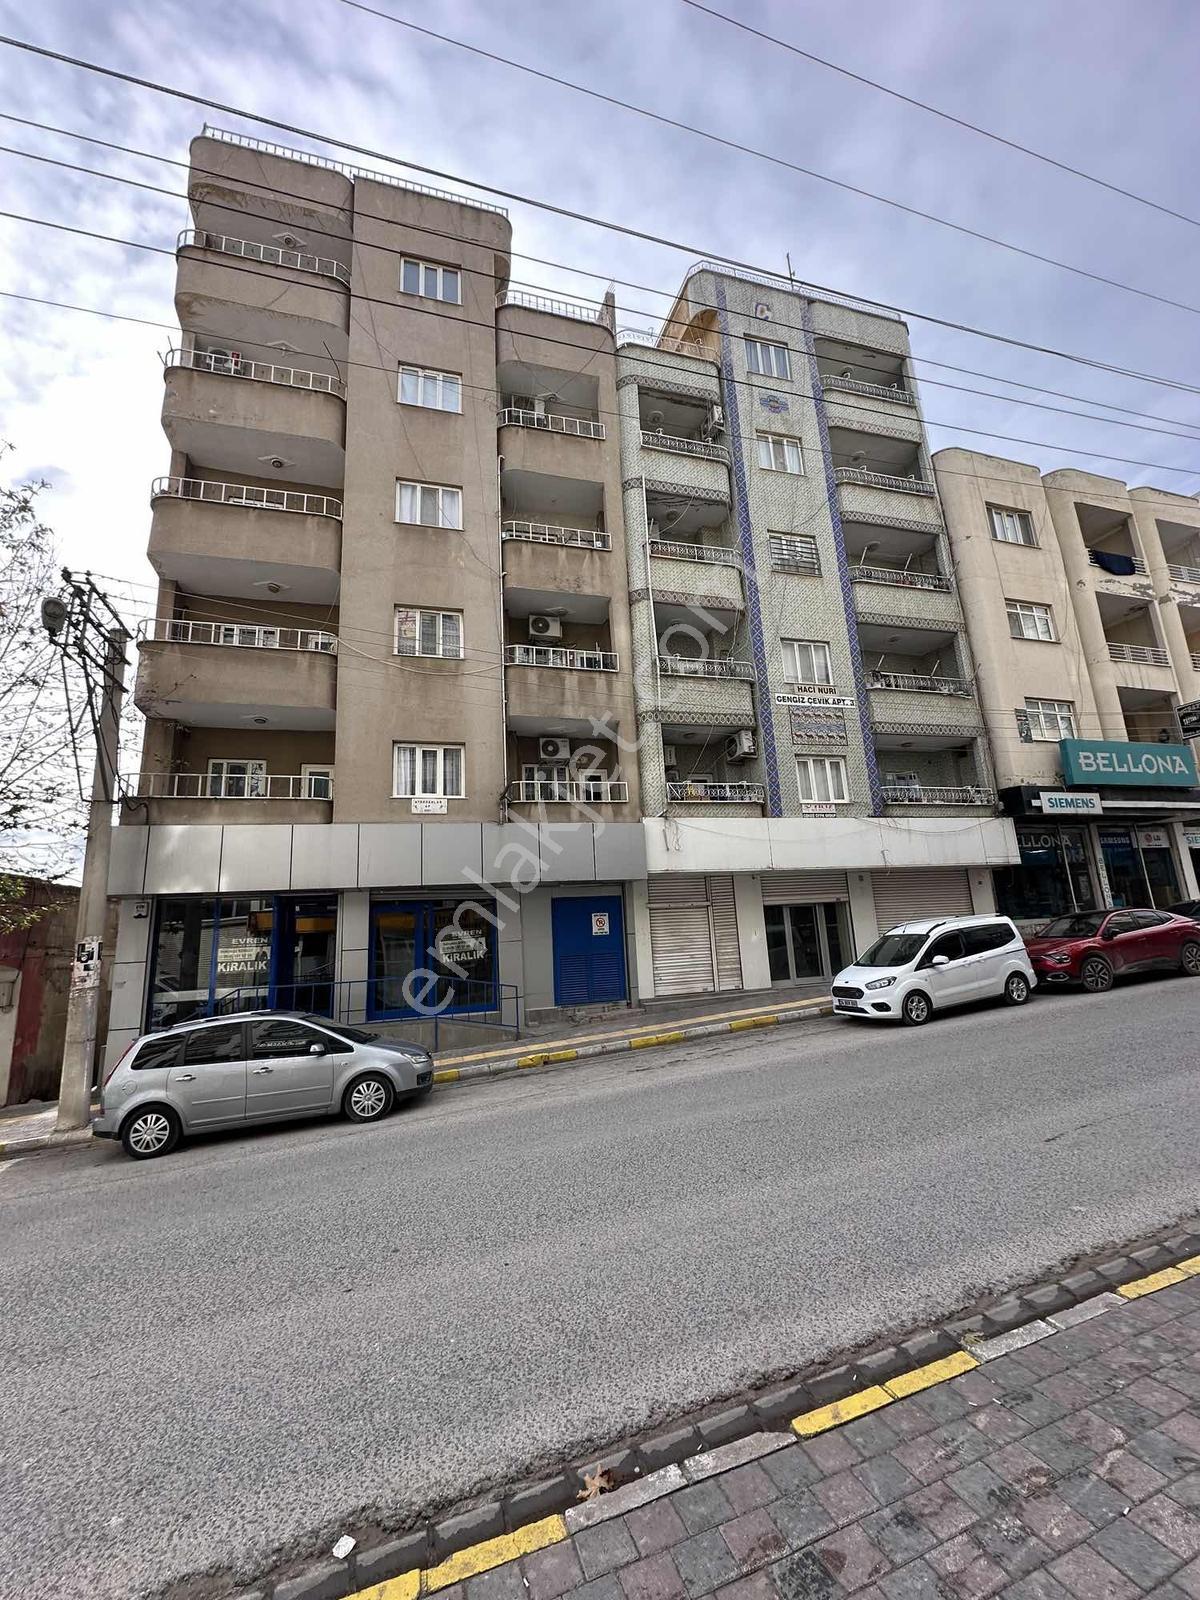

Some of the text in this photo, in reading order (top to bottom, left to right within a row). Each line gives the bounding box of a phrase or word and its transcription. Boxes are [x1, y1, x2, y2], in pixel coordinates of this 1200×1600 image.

[1078, 751, 1189, 775] BELLONA
[1047, 797, 1096, 809] SIEMENS
[231, 937, 269, 945] EVREN
